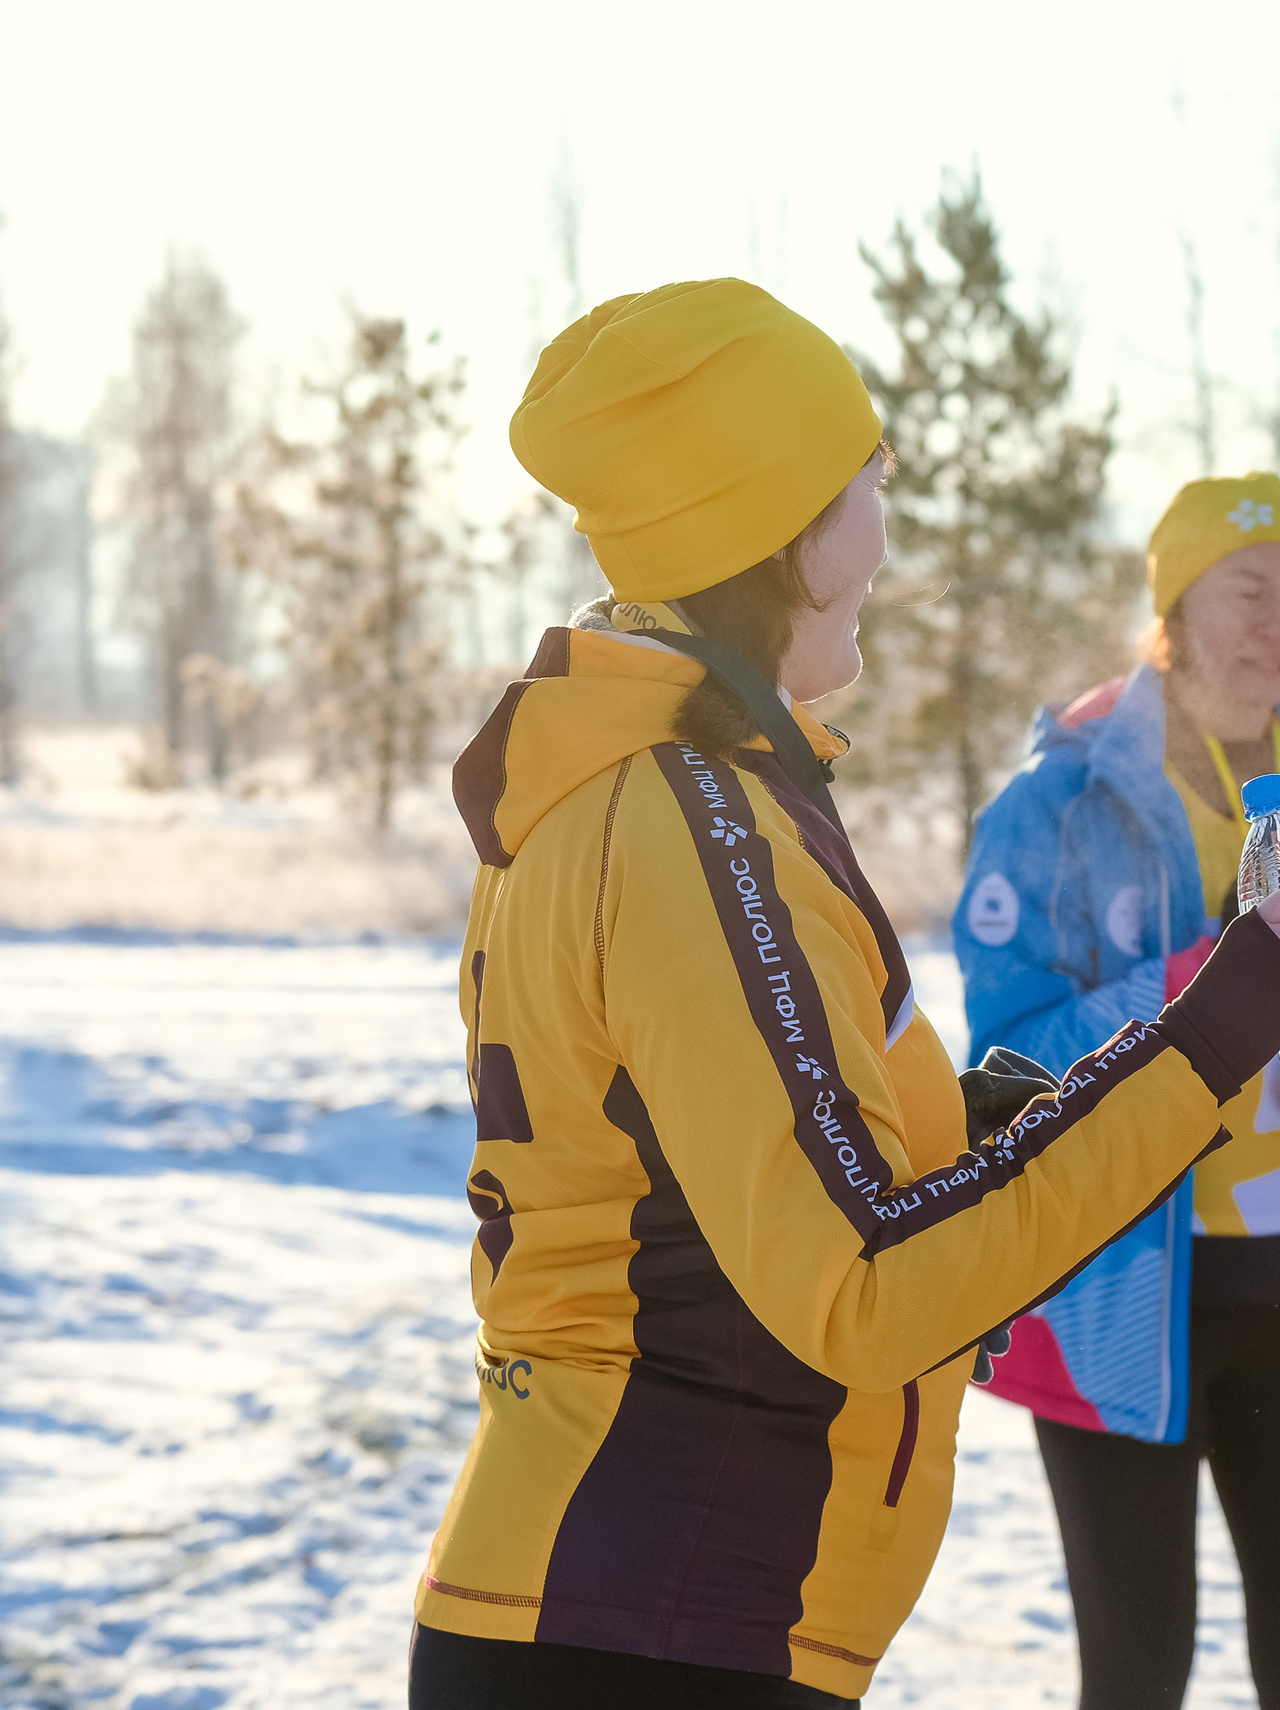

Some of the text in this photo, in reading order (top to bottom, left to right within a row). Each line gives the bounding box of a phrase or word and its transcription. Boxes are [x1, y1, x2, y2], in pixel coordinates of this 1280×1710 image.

[691, 770, 728, 809] МФЦ
[730, 857, 804, 1042] МФЦ ПОЛЮС
[812, 1088, 869, 1188] ПОЛЮС
[925, 1156, 988, 1197] МФЦ
